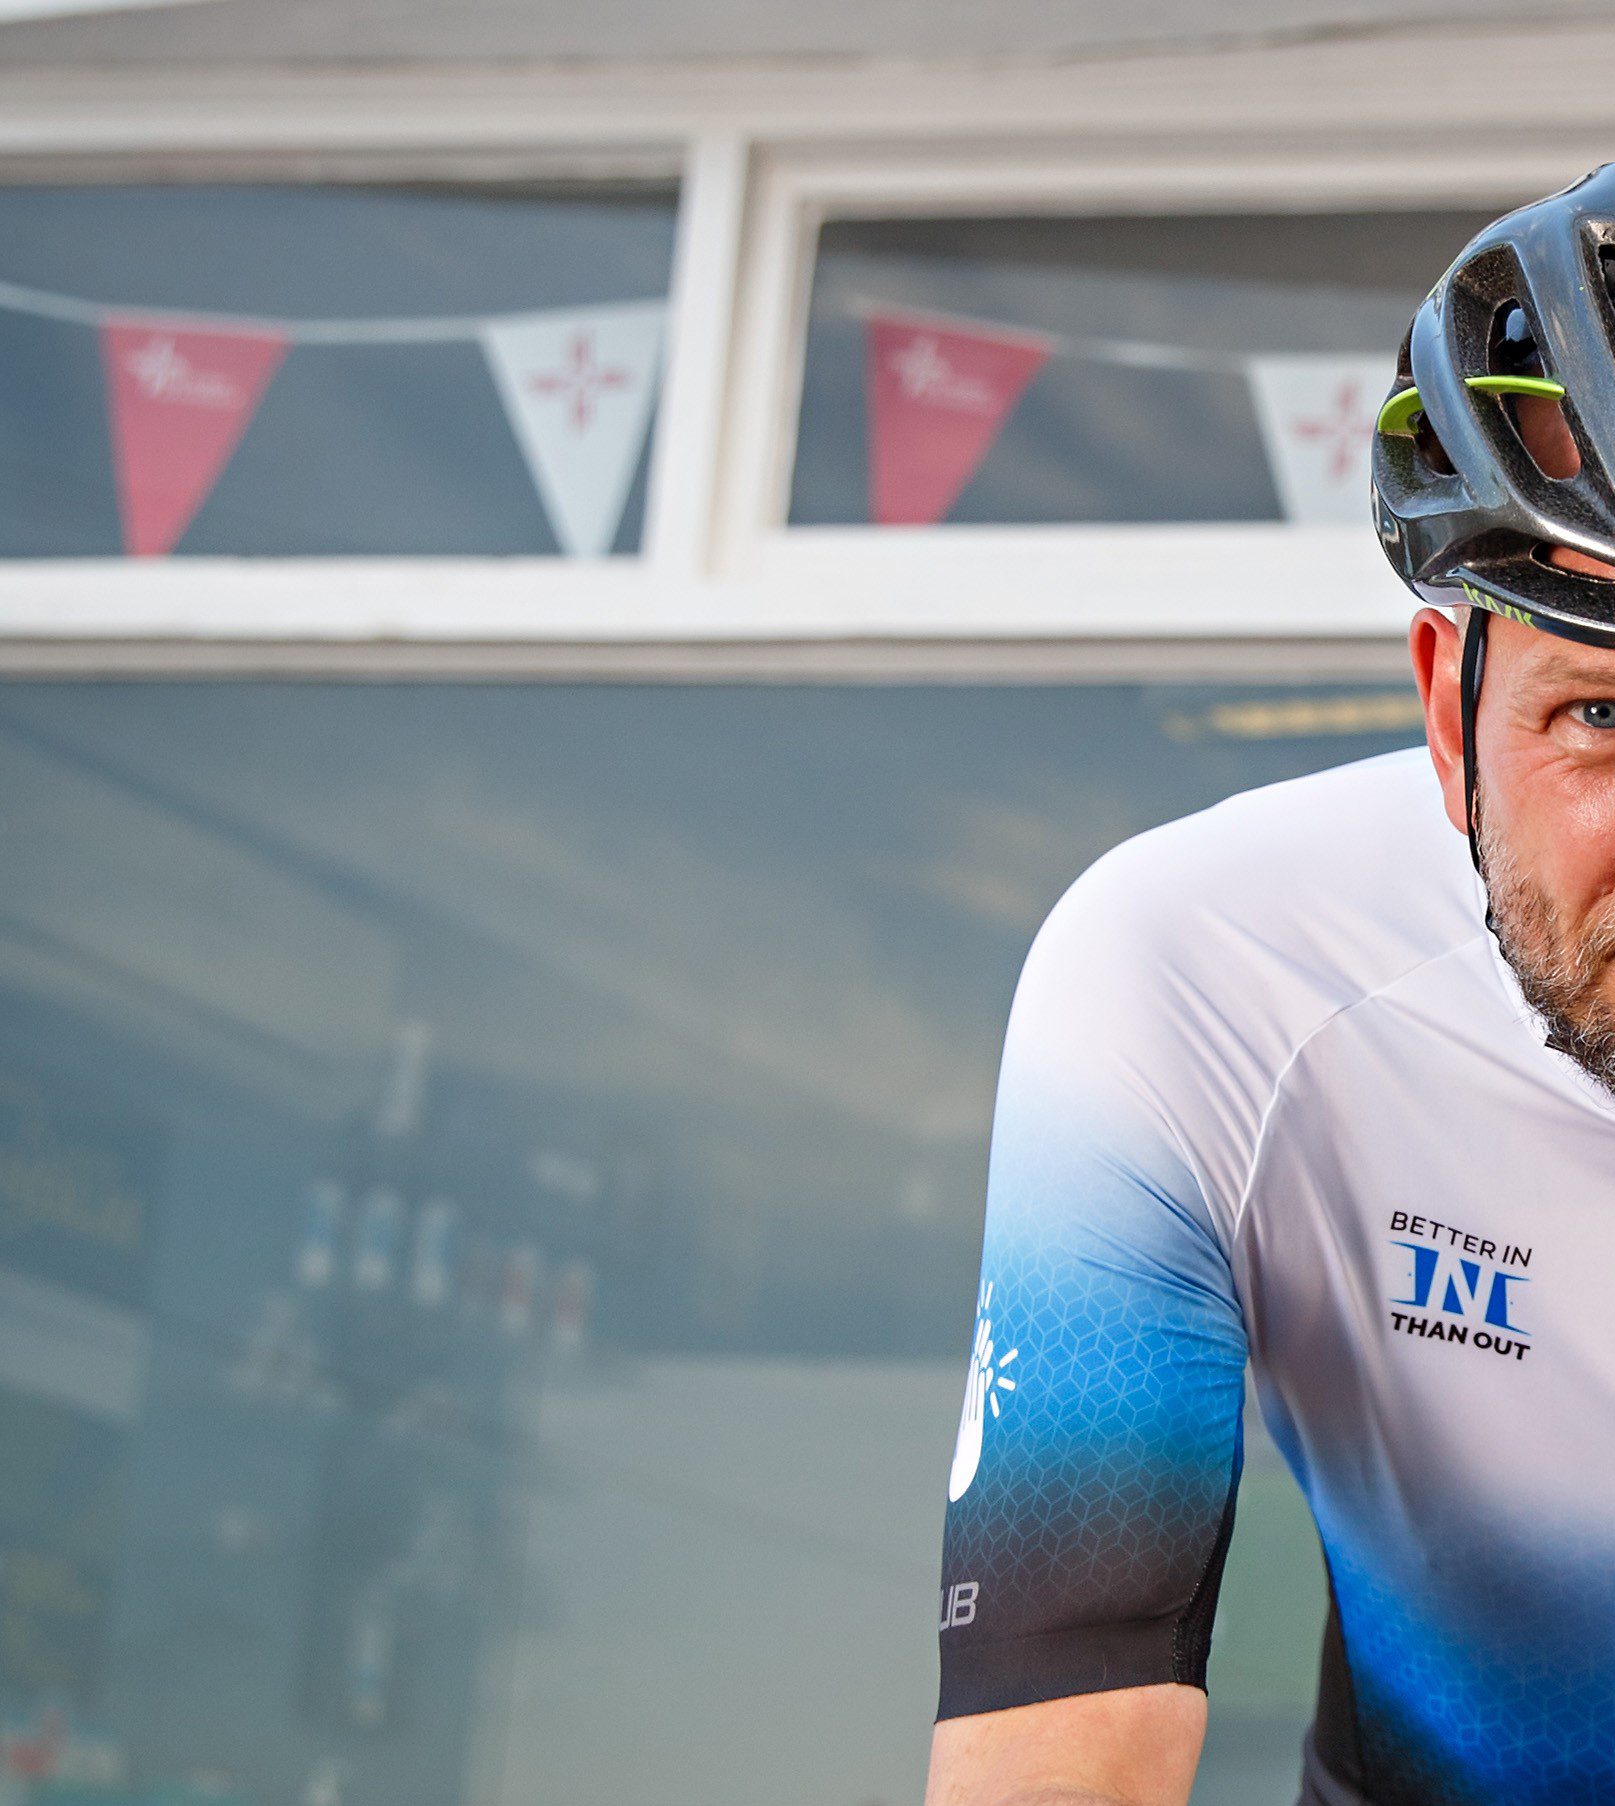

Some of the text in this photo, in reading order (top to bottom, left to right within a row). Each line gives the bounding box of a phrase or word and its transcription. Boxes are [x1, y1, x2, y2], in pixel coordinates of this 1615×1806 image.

[1390, 1210, 1533, 1268] BETTER IN
[1390, 1312, 1532, 1361] THAN OUT
